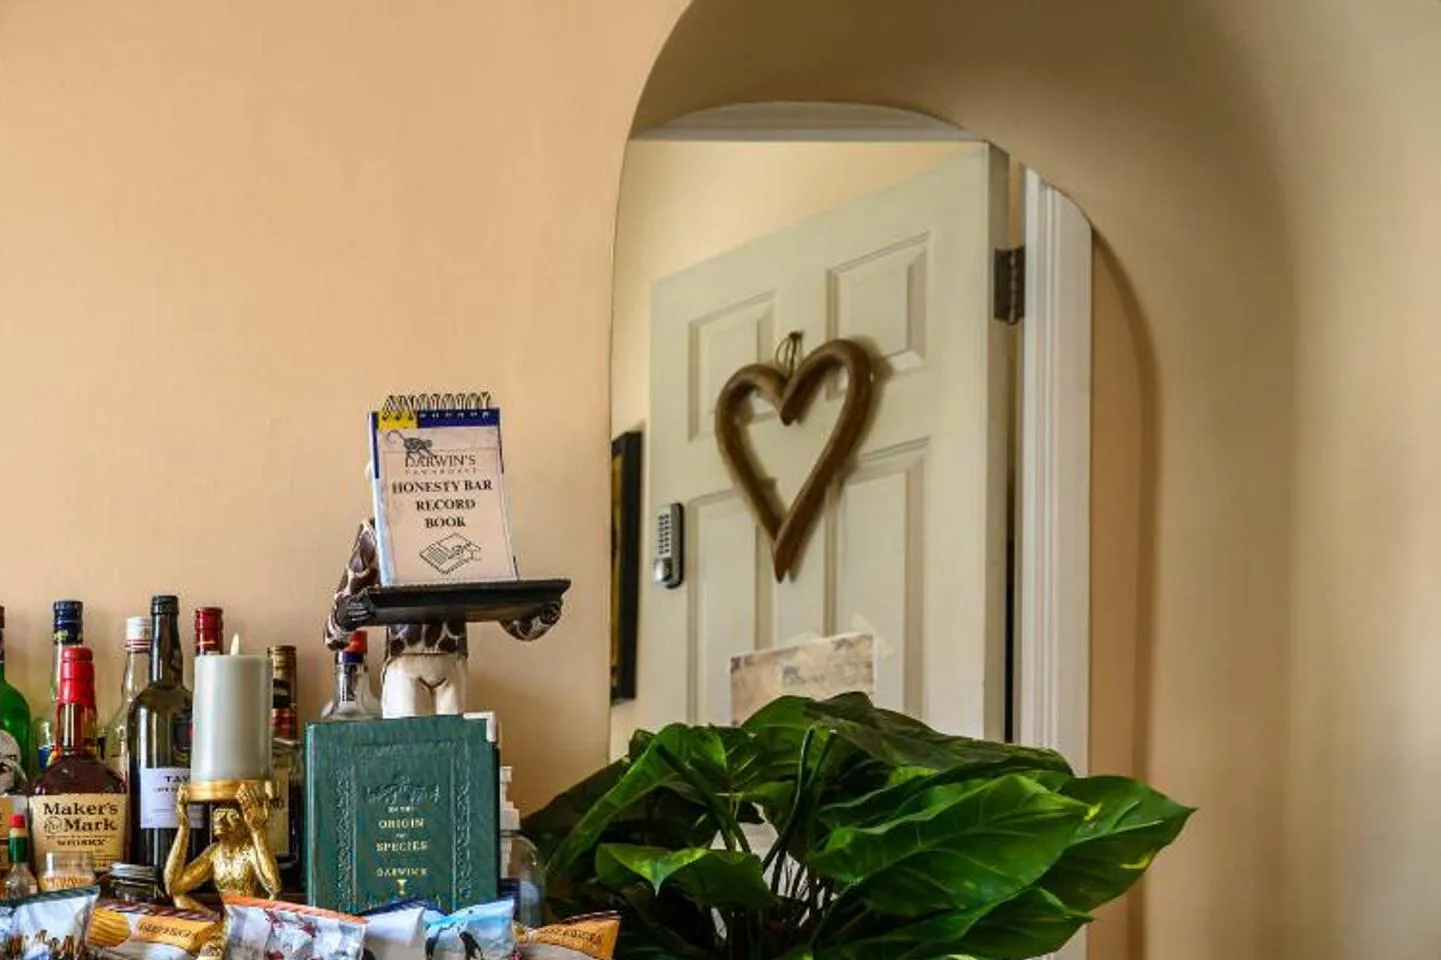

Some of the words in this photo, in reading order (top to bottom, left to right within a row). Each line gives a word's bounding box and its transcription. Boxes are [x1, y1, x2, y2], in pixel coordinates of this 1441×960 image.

[405, 455, 476, 467] DARWIN'S
[392, 480, 460, 494] HONESTY
[464, 479, 493, 491] BAR
[416, 499, 476, 511] RECORD
[425, 516, 466, 529] BOOK
[165, 775, 189, 784] TAY
[43, 802, 119, 816] Maker's
[64, 817, 118, 833] Mark
[378, 817, 425, 829] ORIGIN
[376, 840, 428, 852] SPECIES
